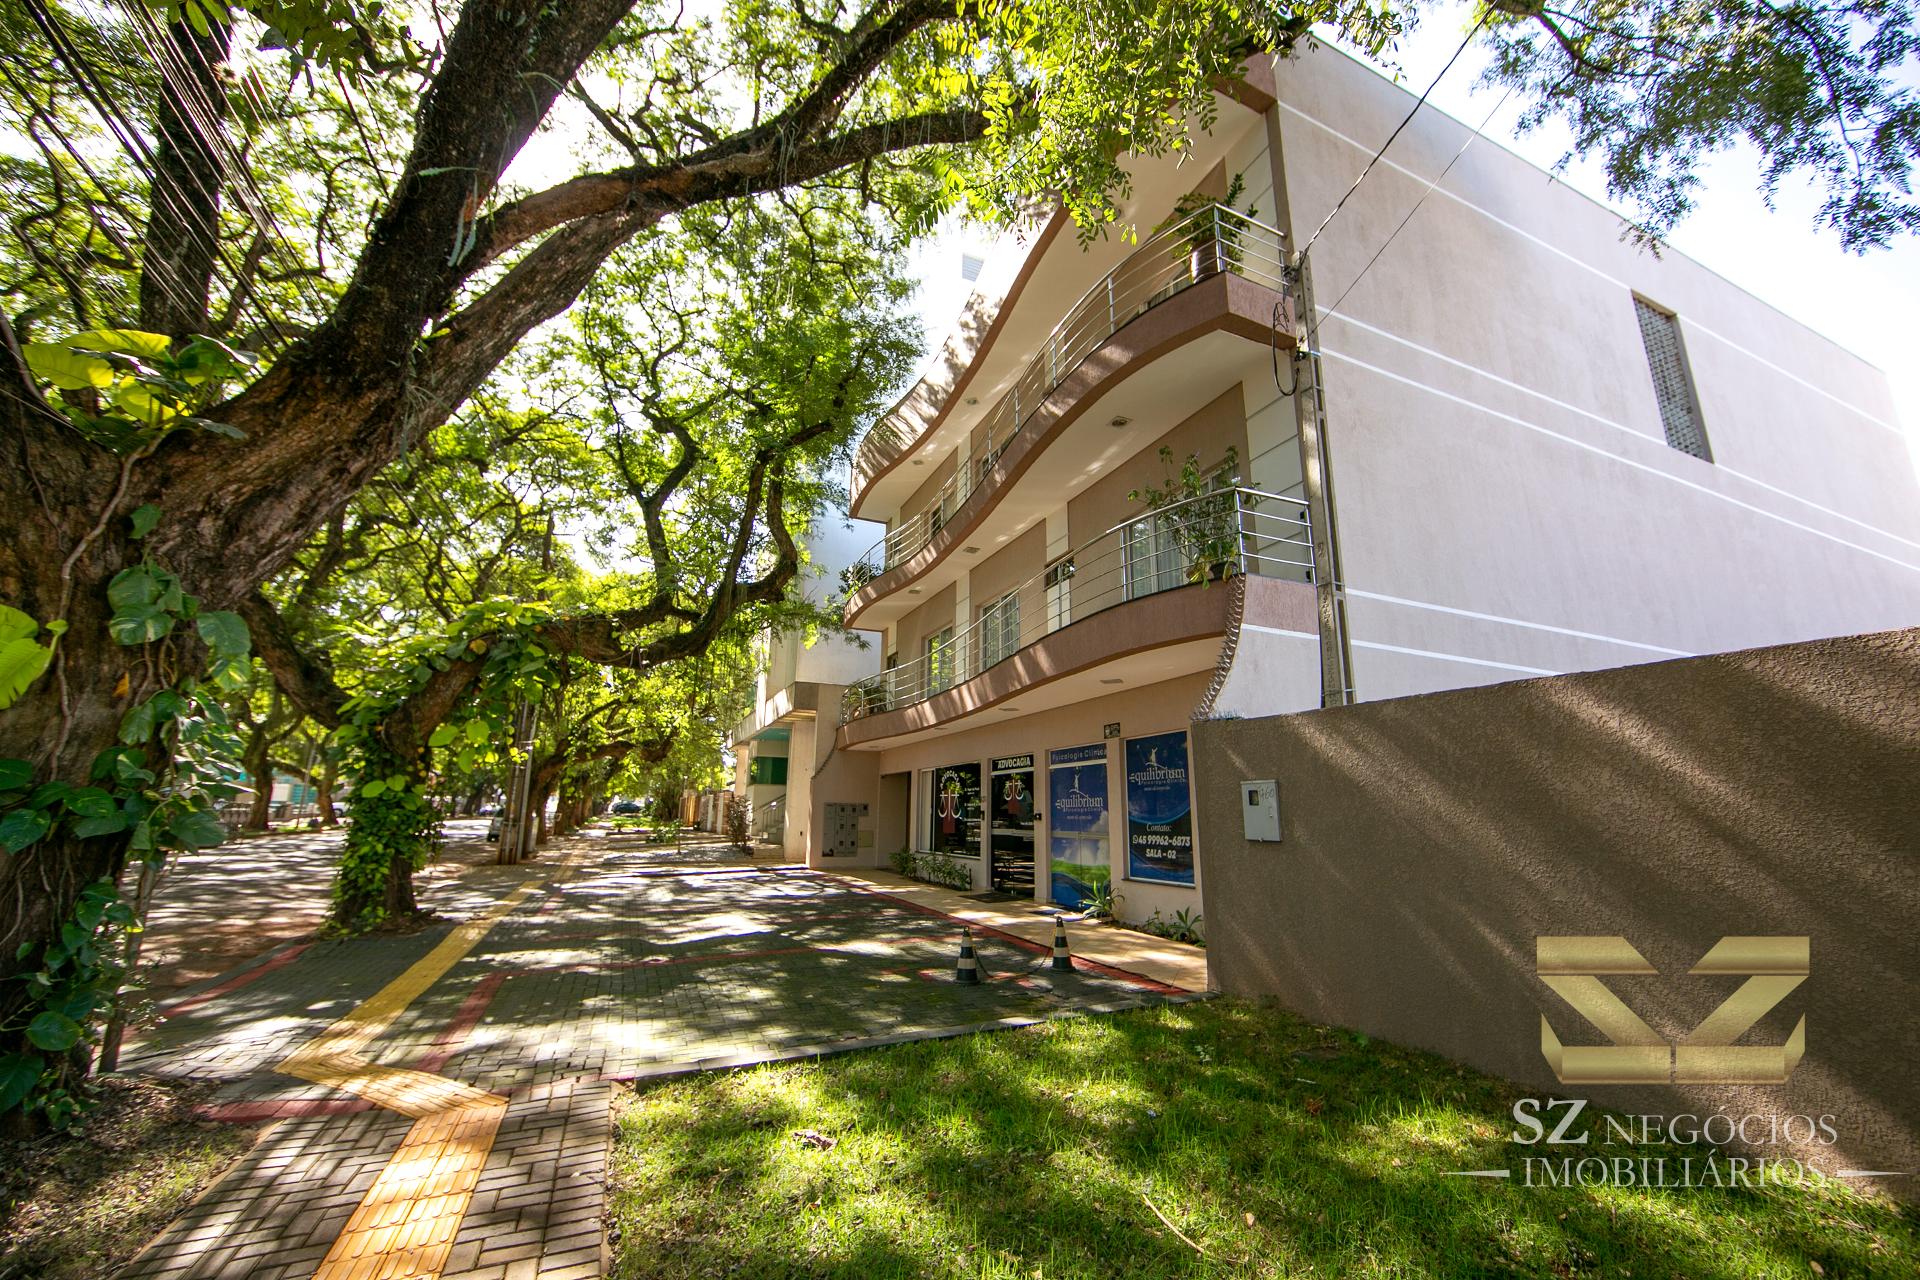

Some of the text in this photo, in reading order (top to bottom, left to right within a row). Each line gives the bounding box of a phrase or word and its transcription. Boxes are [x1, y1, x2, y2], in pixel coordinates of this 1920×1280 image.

[997, 756, 1031, 769] ADVOCACIA
[1146, 849, 1162, 858] SALA
[1167, 850, 1177, 859] 02
